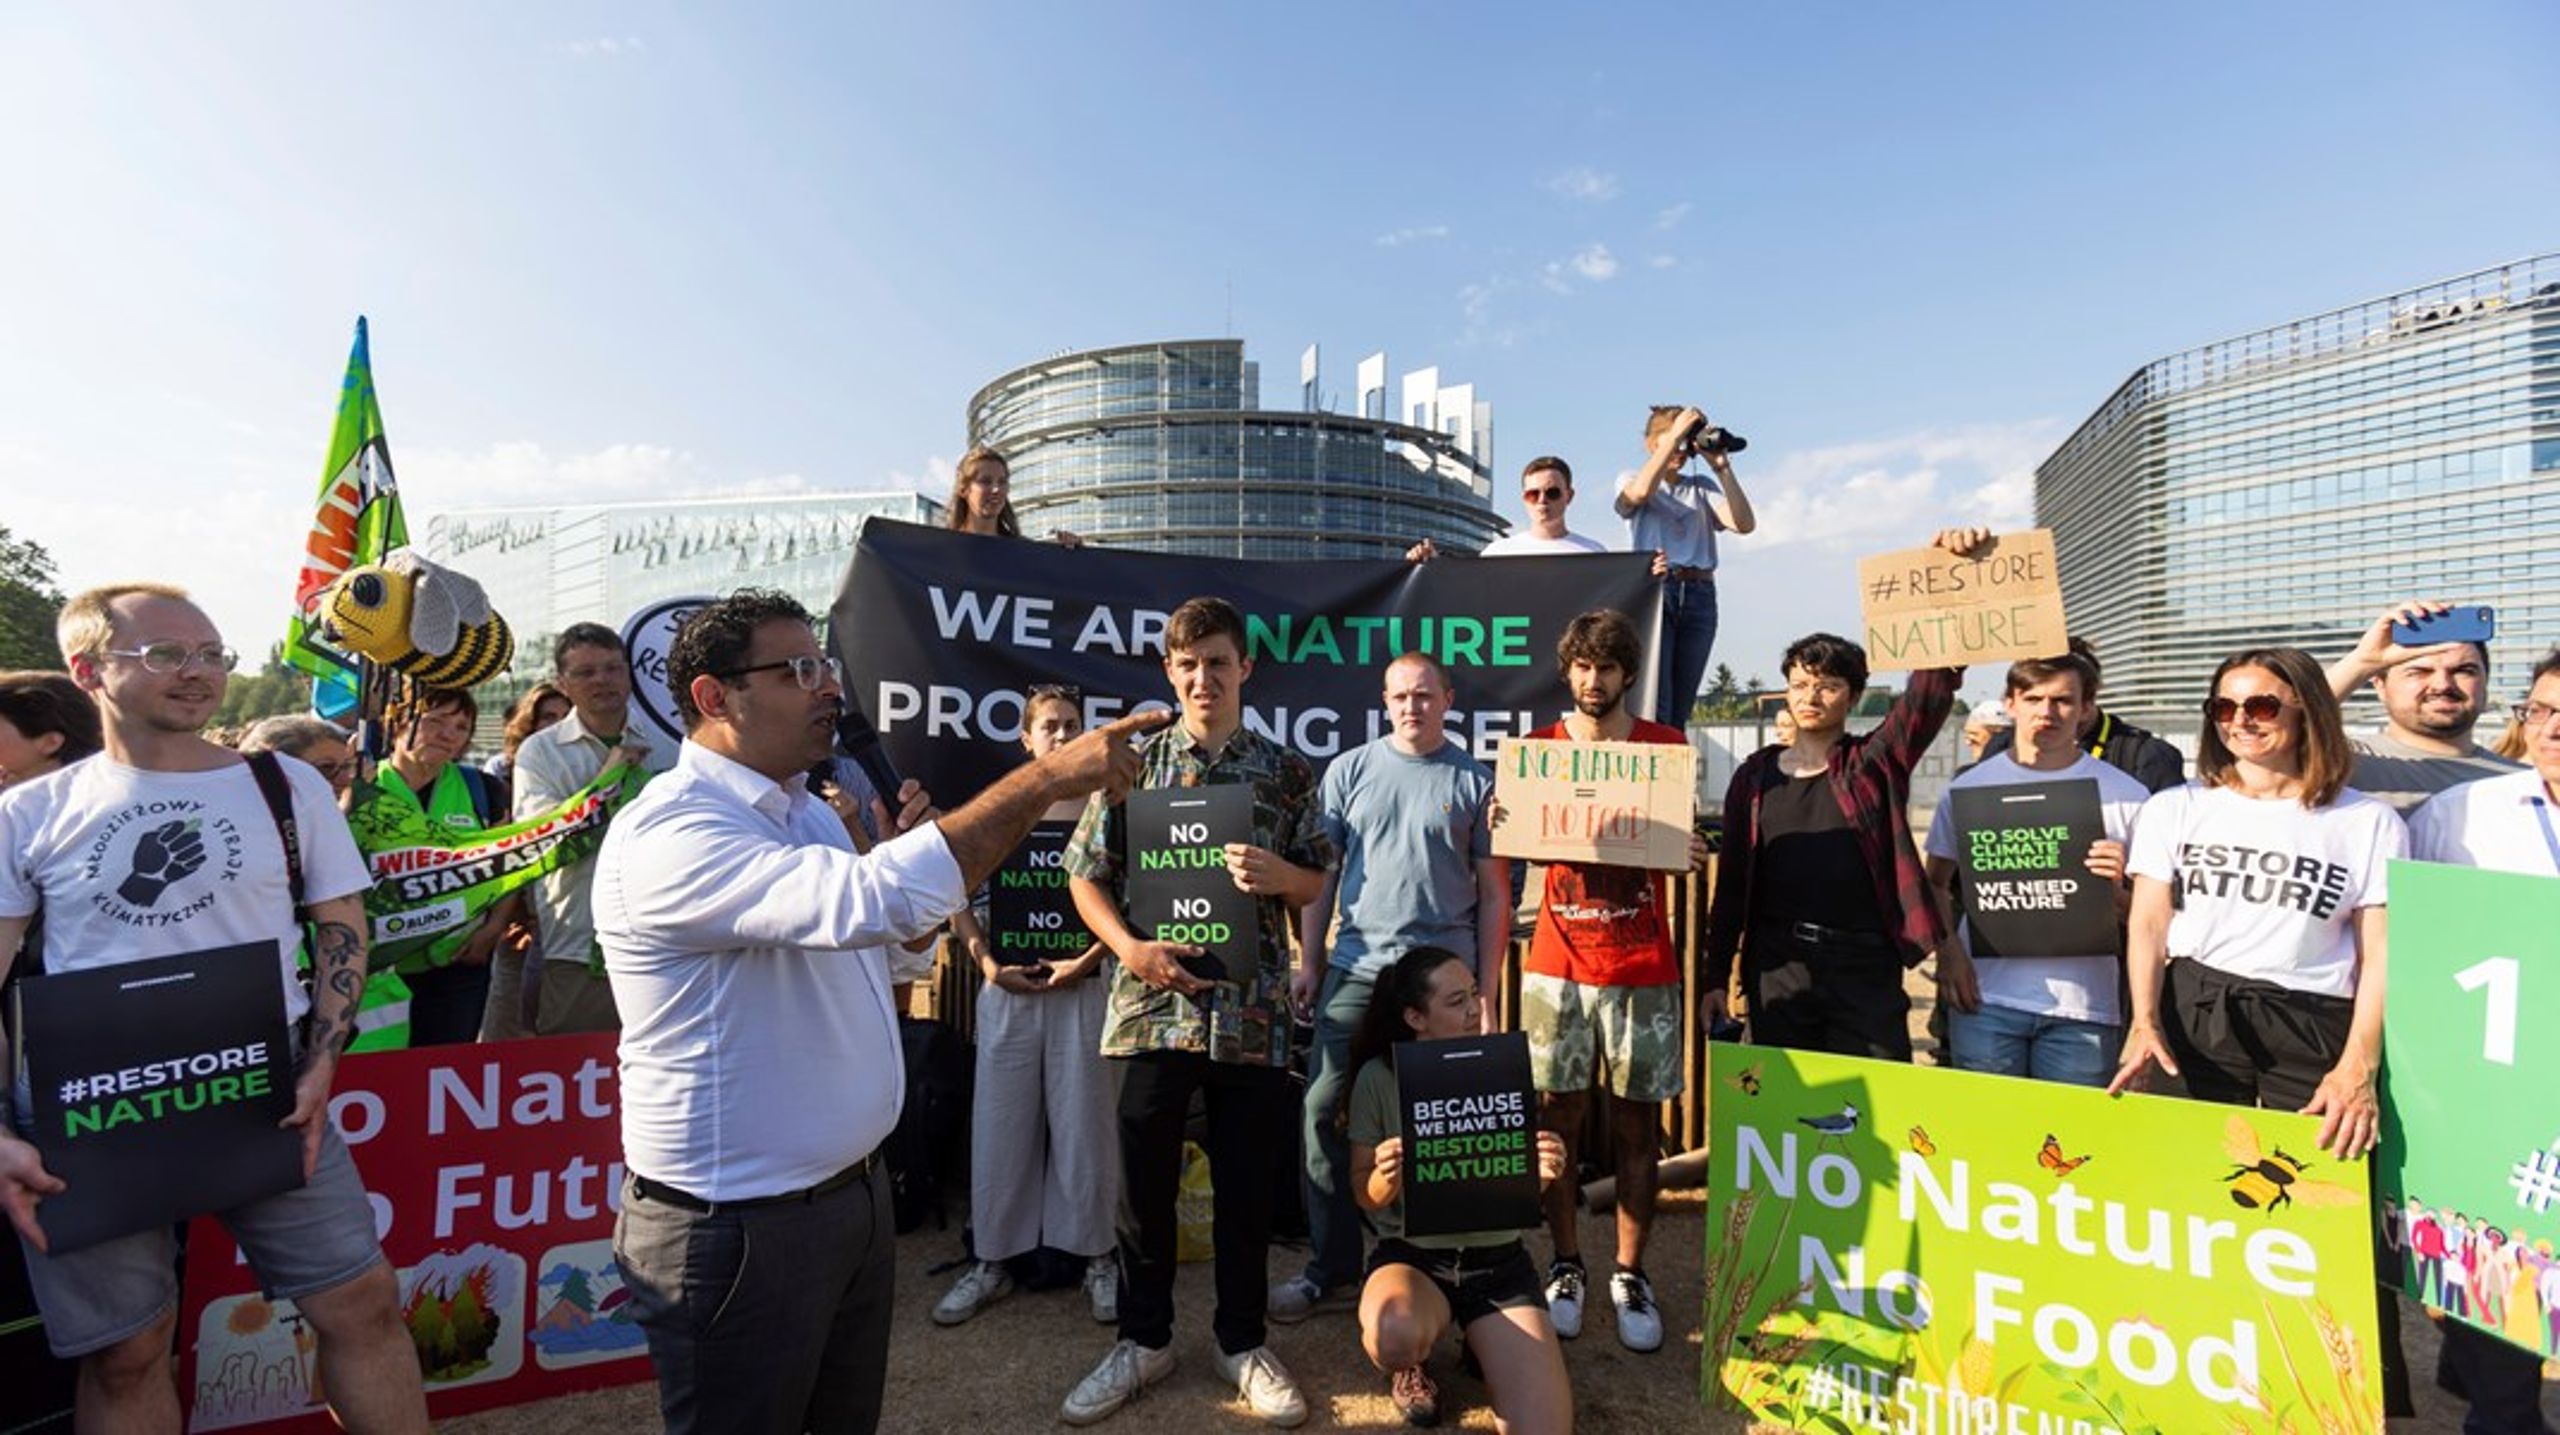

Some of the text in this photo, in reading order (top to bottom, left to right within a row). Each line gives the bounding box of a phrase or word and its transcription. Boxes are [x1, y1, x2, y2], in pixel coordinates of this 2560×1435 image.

[1870, 552, 2044, 600] #RESTORE
[928, 585, 1532, 667] WE AR NATURE
[1869, 604, 2040, 661] NATURE
[634, 647, 668, 684] RE
[1518, 746, 1662, 782] NO NATURE
[1170, 823, 1208, 844] NO
[1541, 803, 1650, 840] NO FOOD
[1968, 826, 2070, 845] TO SOLVE
[1029, 851, 1063, 868] NO
[1140, 847, 1226, 870] NATUR
[1971, 841, 2060, 858] CLIMATE
[1972, 854, 2060, 872] CHANGE
[403, 857, 495, 899] STATT
[1001, 870, 1069, 889] NATU
[2180, 843, 2349, 892] ESTORE
[1975, 879, 2078, 897] WE NEED
[1173, 898, 1212, 919] NO
[1978, 893, 2067, 912] NATURE
[1028, 912, 1063, 929] NO
[1157, 923, 1231, 945] FOOD
[1002, 932, 1089, 949] FUTURE
[60, 1042, 269, 1103] #RESTORE
[65, 1068, 272, 1139] NATURE
[327, 1056, 612, 1145] o Nat
[1413, 1092, 1525, 1120] BECAUSE
[1414, 1112, 1526, 1137] WE HAVE TO
[1415, 1131, 1527, 1158] RESTORE
[1416, 1154, 1528, 1183] NATURE
[1735, 1125, 2318, 1298] No Nature
[1799, 1233, 2261, 1412] No Food
